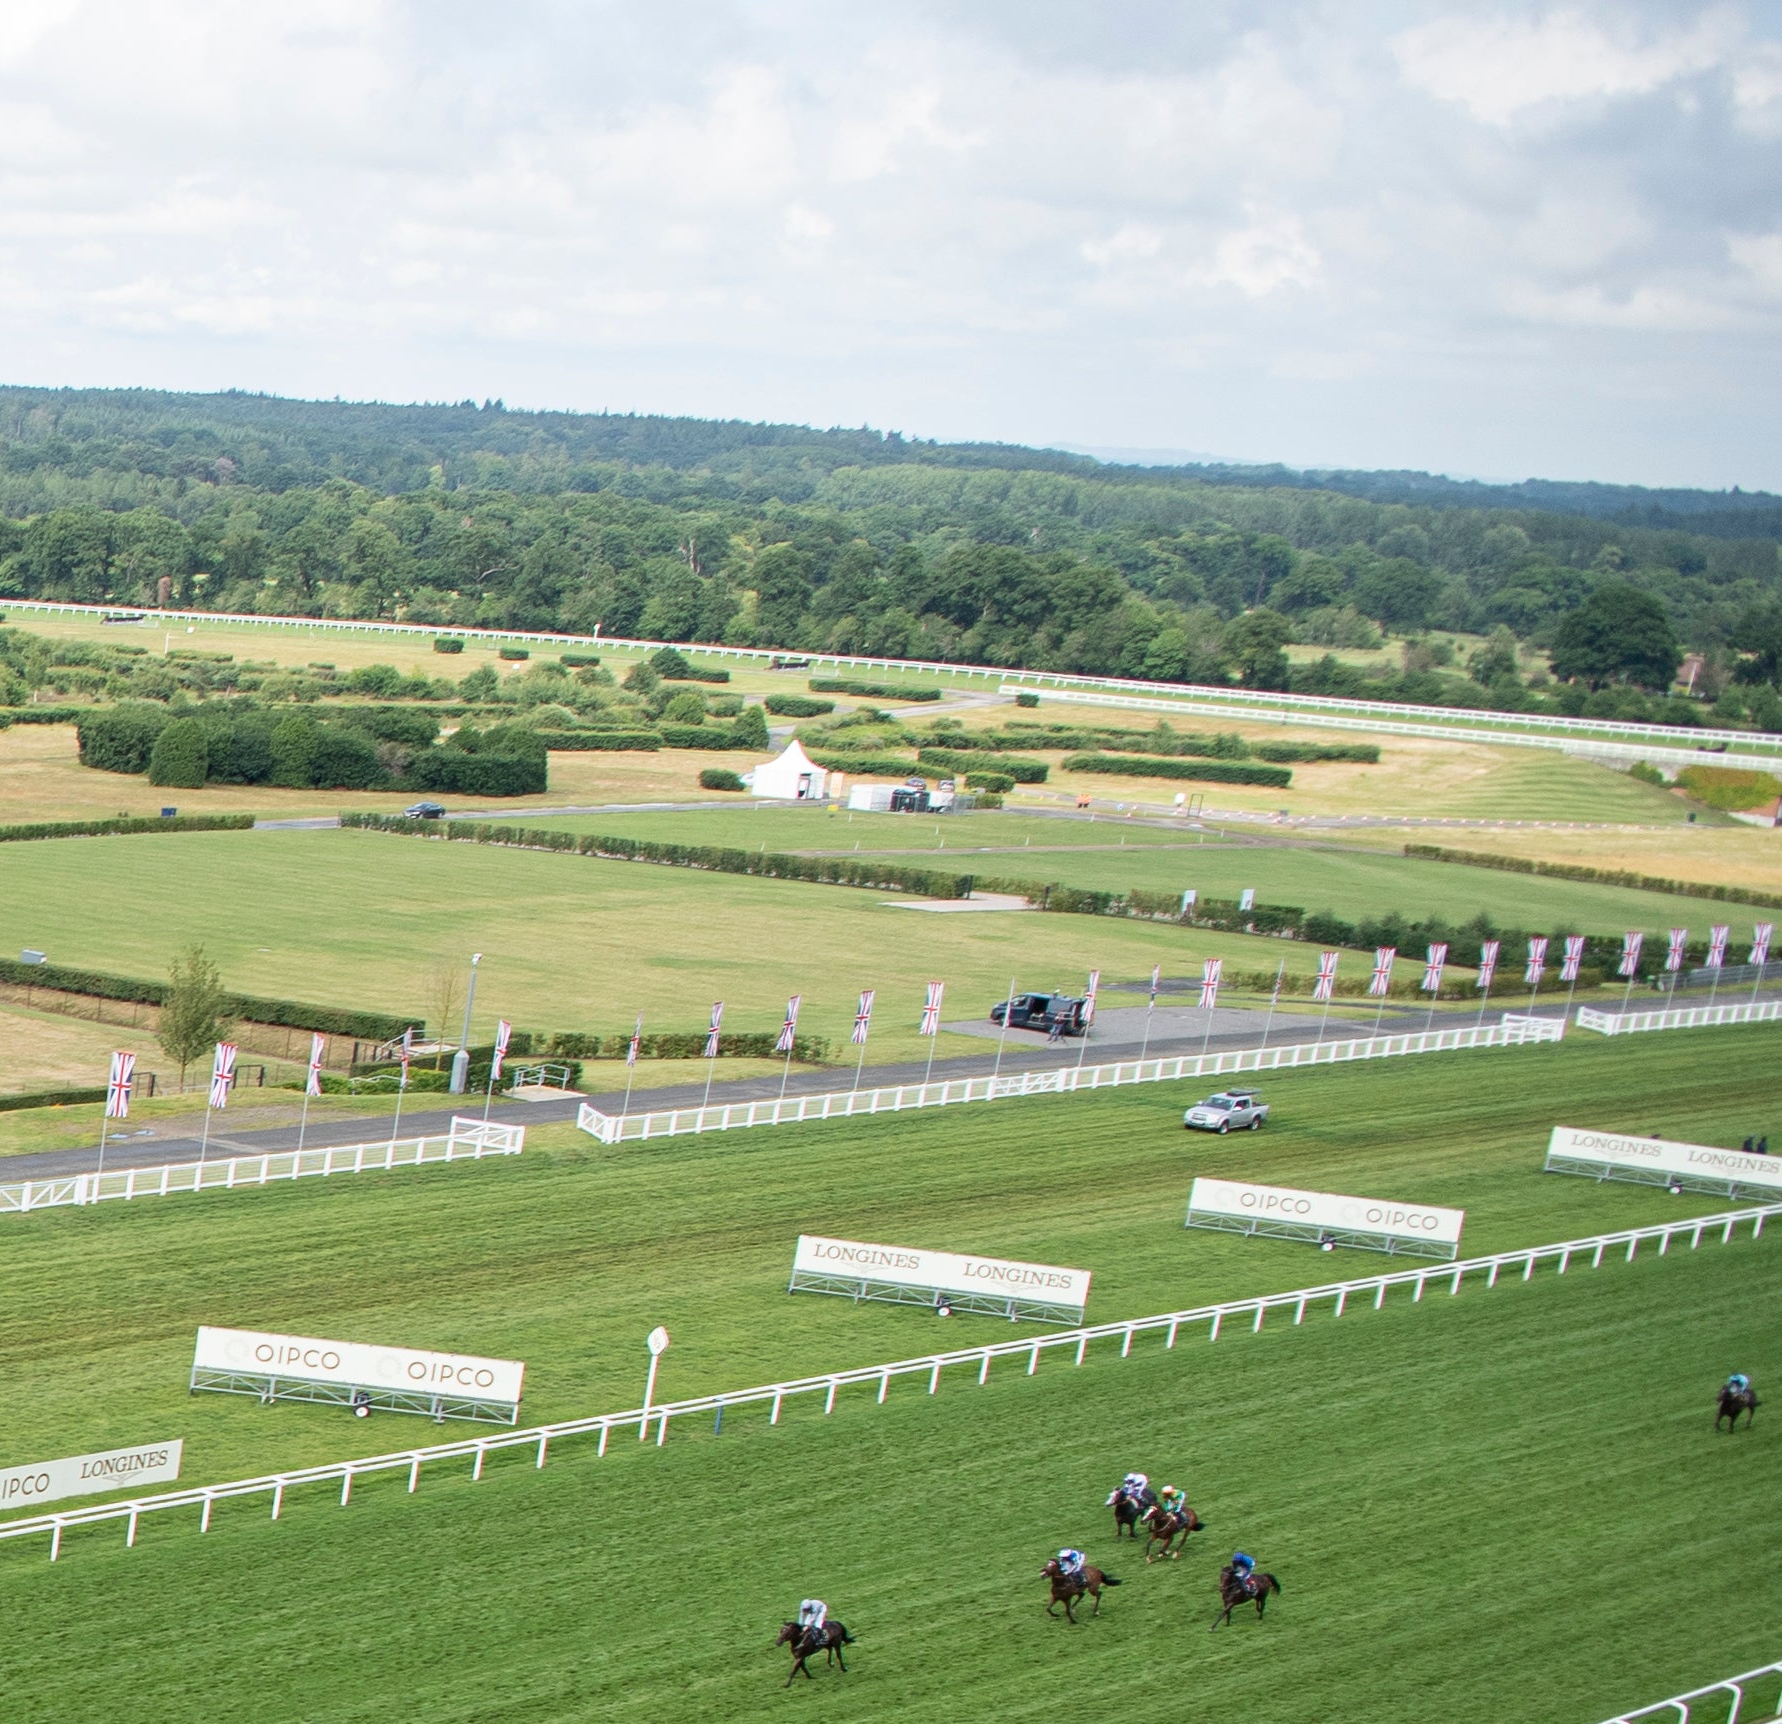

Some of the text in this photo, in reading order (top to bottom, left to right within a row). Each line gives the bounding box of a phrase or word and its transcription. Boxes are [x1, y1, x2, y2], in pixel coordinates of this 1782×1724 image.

[1571, 1134, 1663, 1157] LONGINES
[1687, 1150, 1781, 1174] LONGINES
[812, 1242, 921, 1270] LONGINES
[963, 1261, 1073, 1289] LONGINES
[80, 1449, 169, 1479] LONGINES
